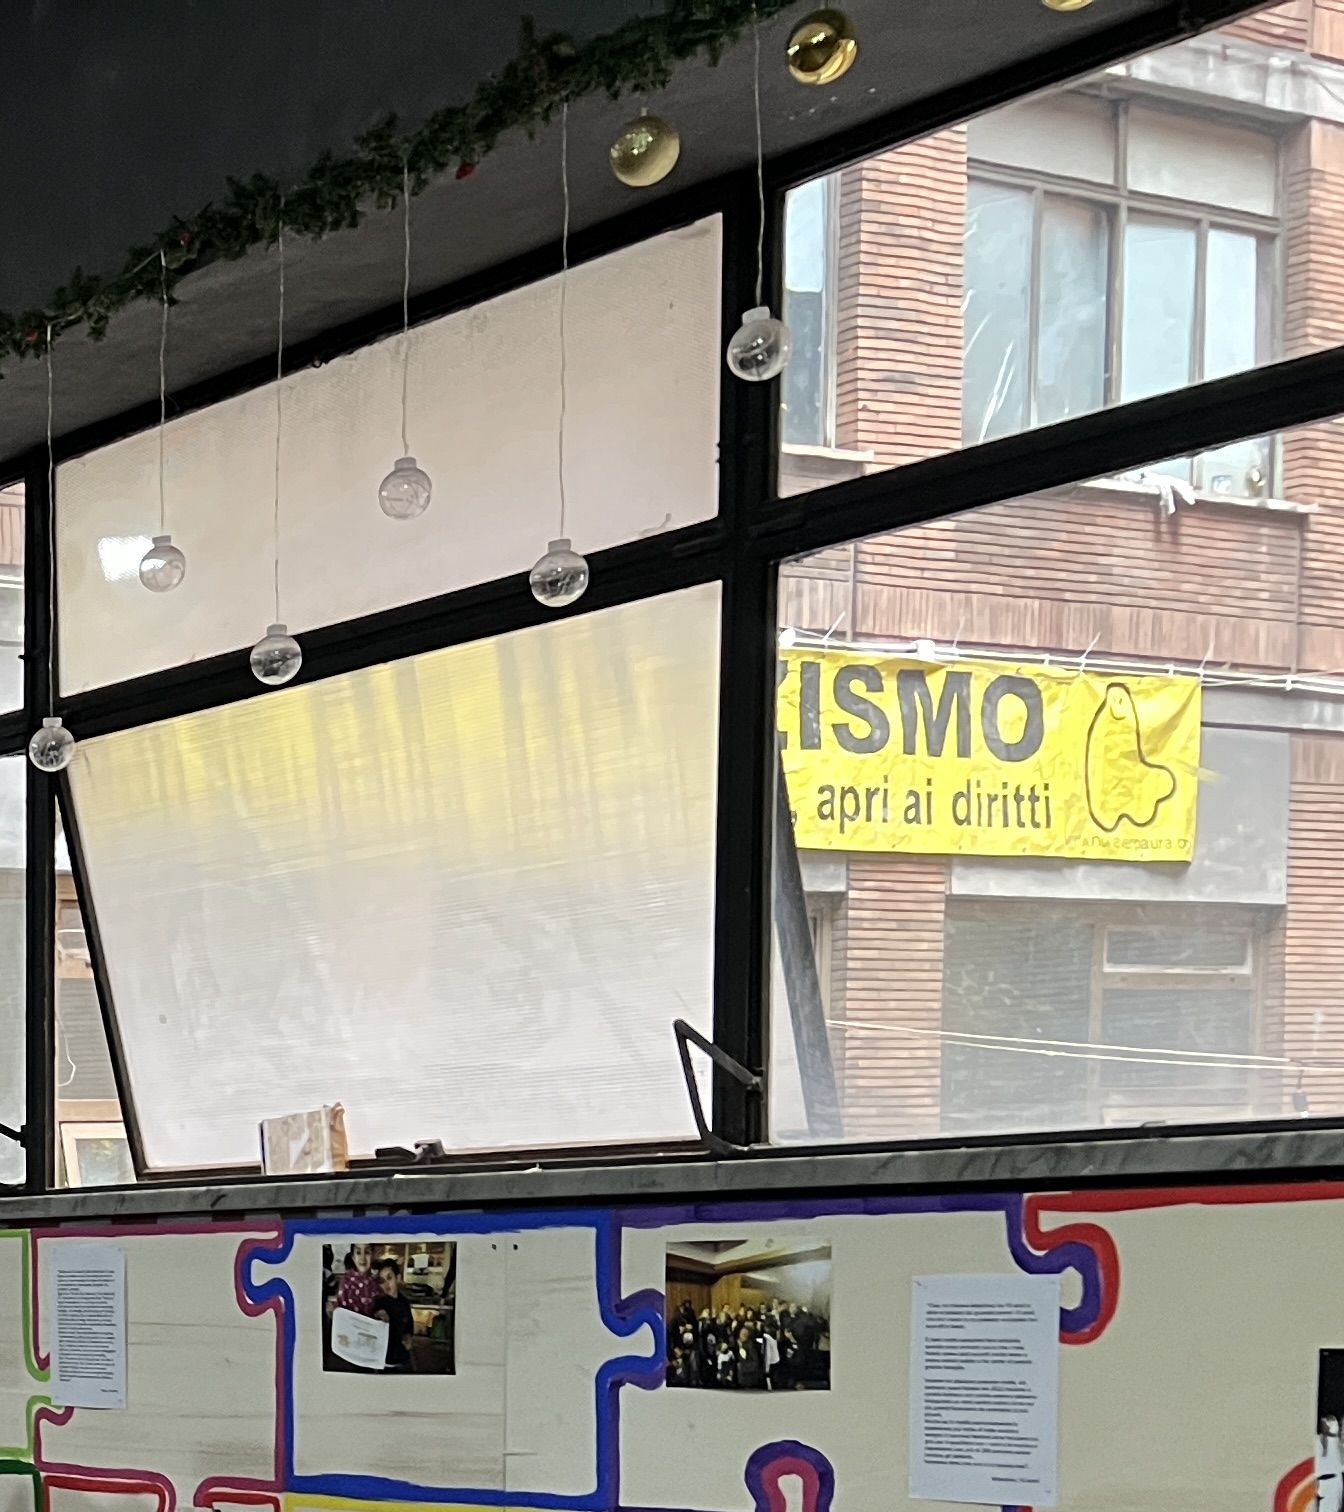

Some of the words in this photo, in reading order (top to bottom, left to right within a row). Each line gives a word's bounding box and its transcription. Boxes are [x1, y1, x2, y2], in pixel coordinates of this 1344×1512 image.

[816, 775, 889, 834] apri
[903, 778, 933, 825] ai
[951, 778, 1052, 829] diritti
